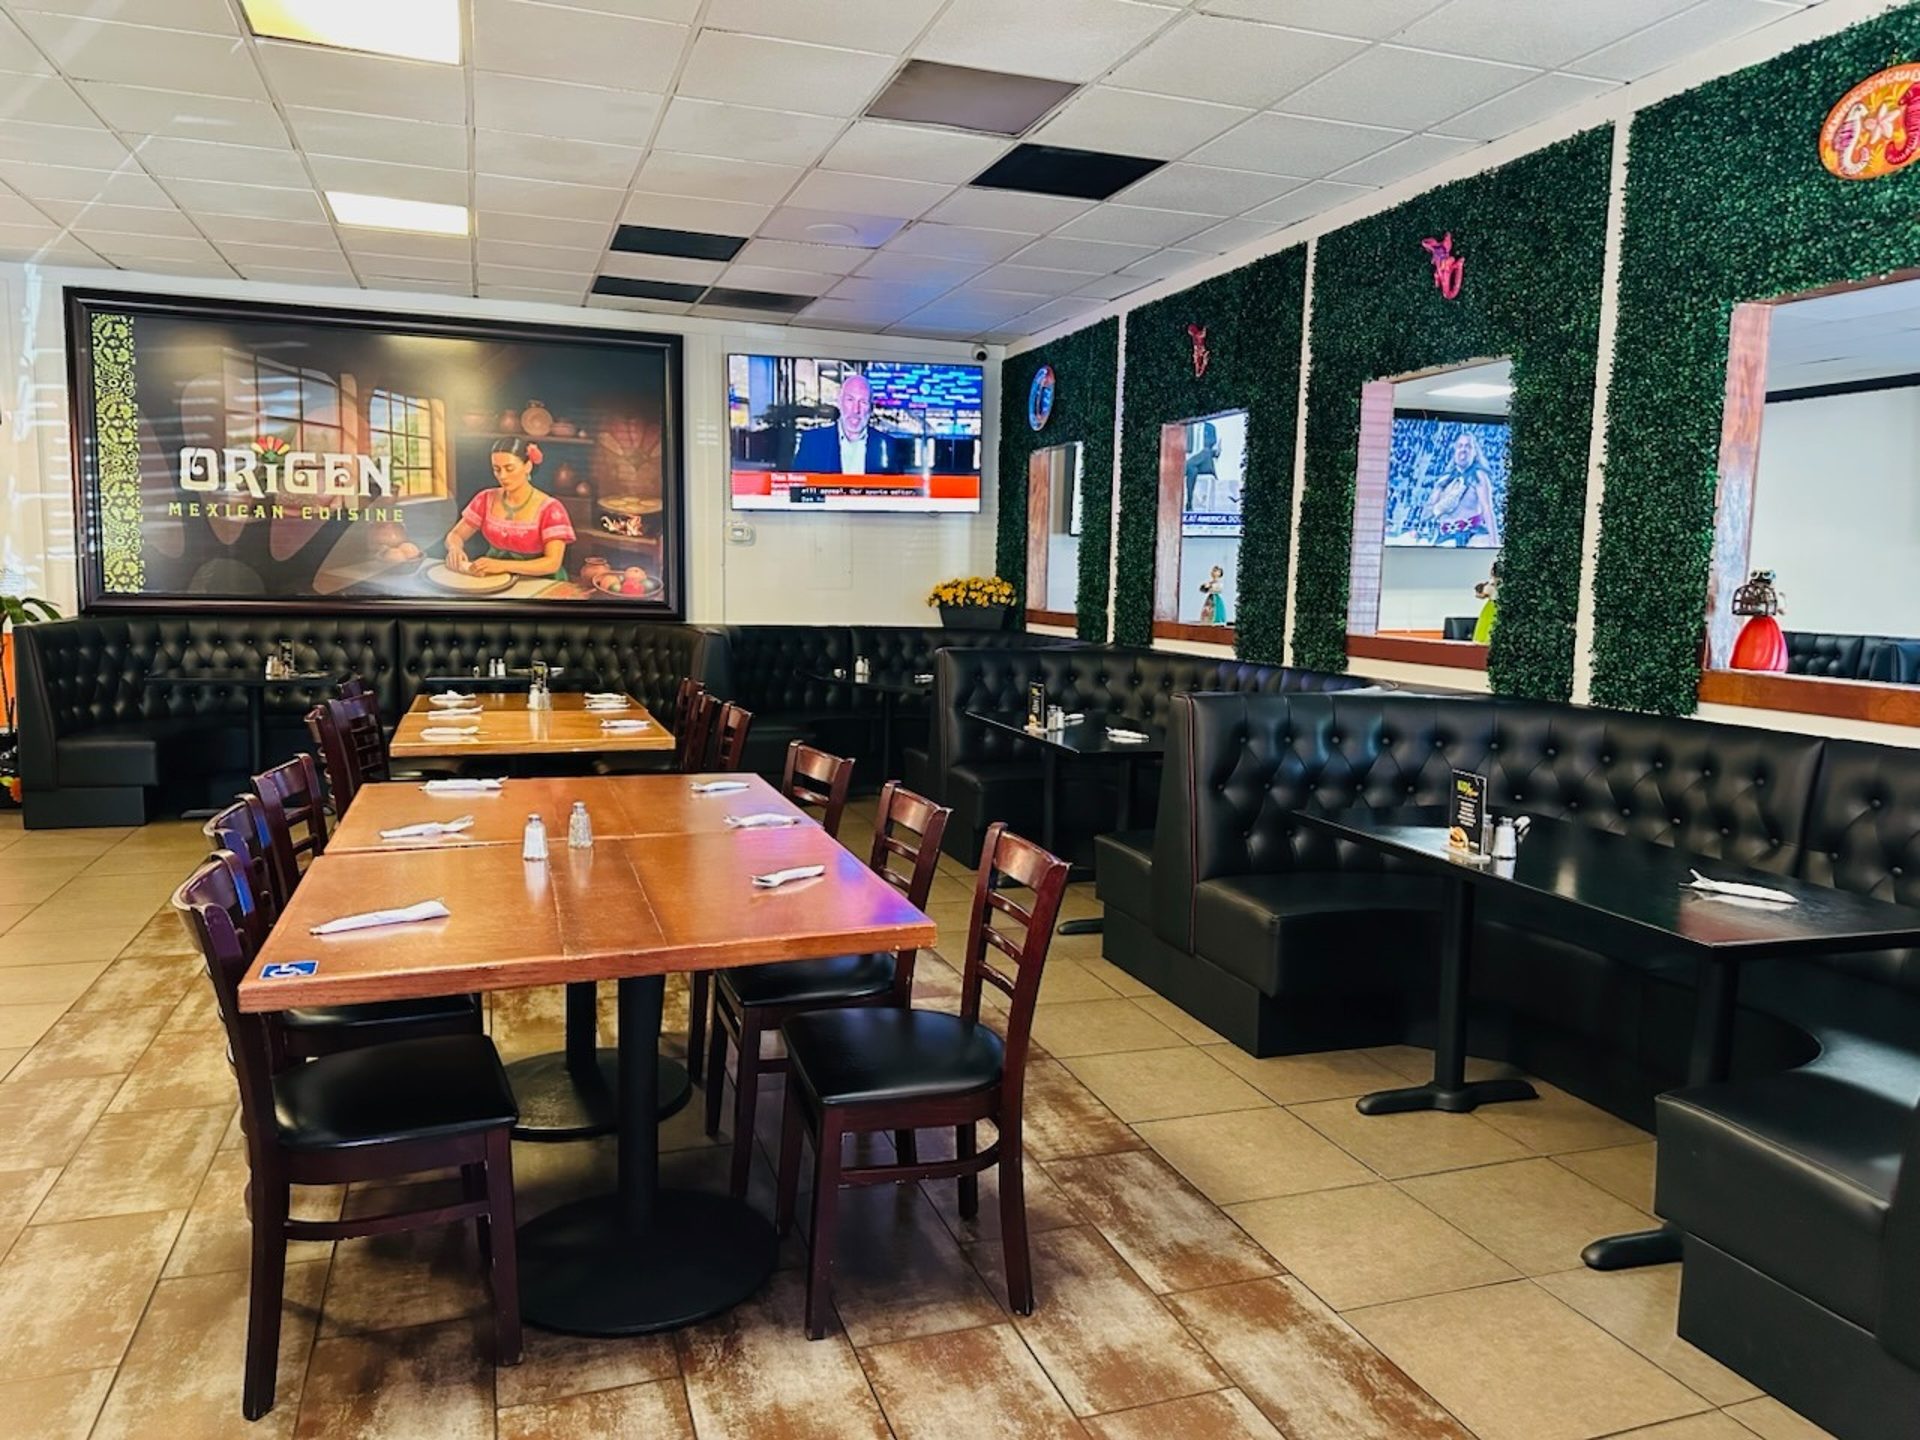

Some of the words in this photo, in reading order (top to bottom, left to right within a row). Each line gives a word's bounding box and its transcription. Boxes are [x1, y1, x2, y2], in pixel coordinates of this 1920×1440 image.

[179, 446, 393, 498] ORIGEN
[167, 501, 284, 519] MEXICAN
[302, 506, 405, 522] CUISINE
